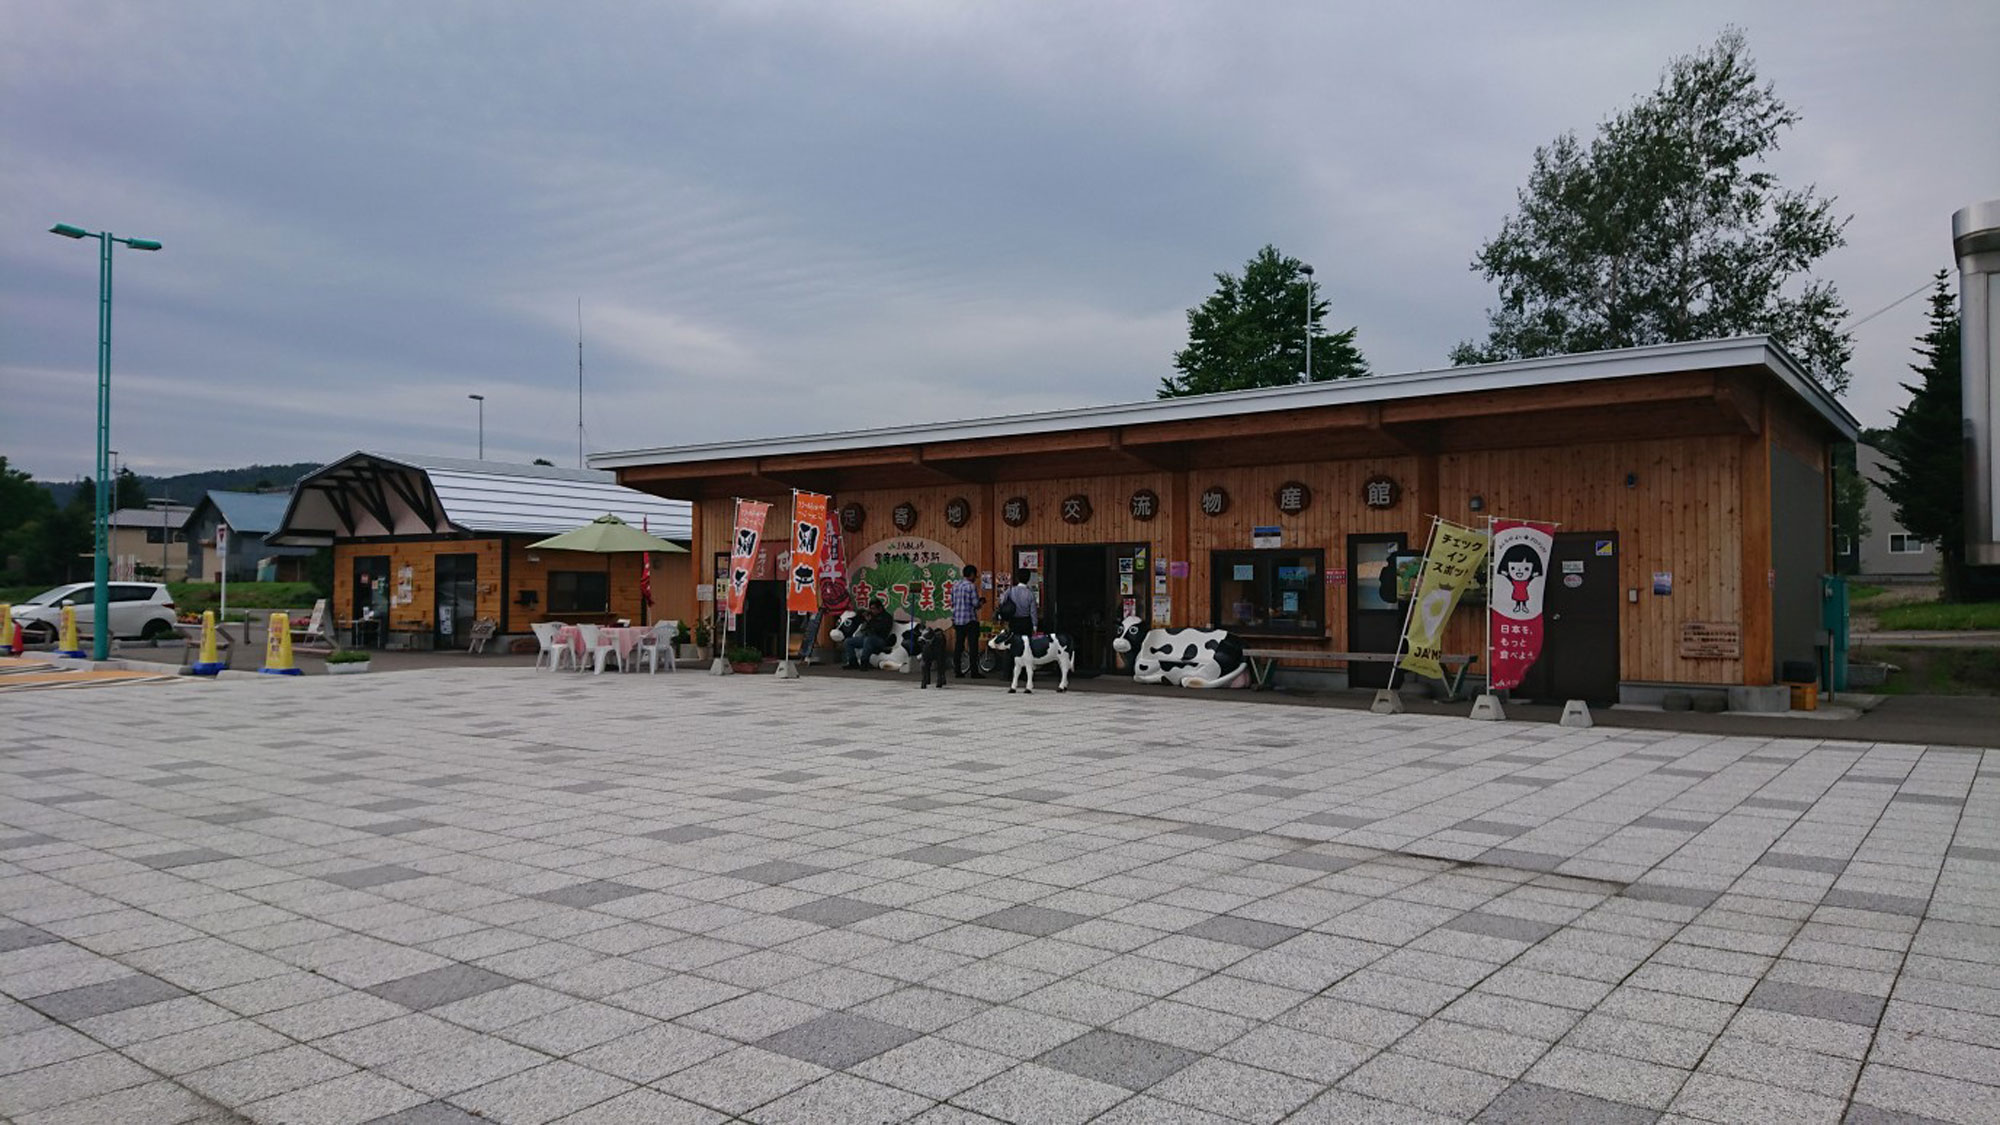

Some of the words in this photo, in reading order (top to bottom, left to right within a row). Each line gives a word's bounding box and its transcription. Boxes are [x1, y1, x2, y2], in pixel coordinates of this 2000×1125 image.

[1441, 533, 1483, 552] チェック
[1447, 551, 1468, 563] イン
[1500, 637, 1527, 648] もっと
